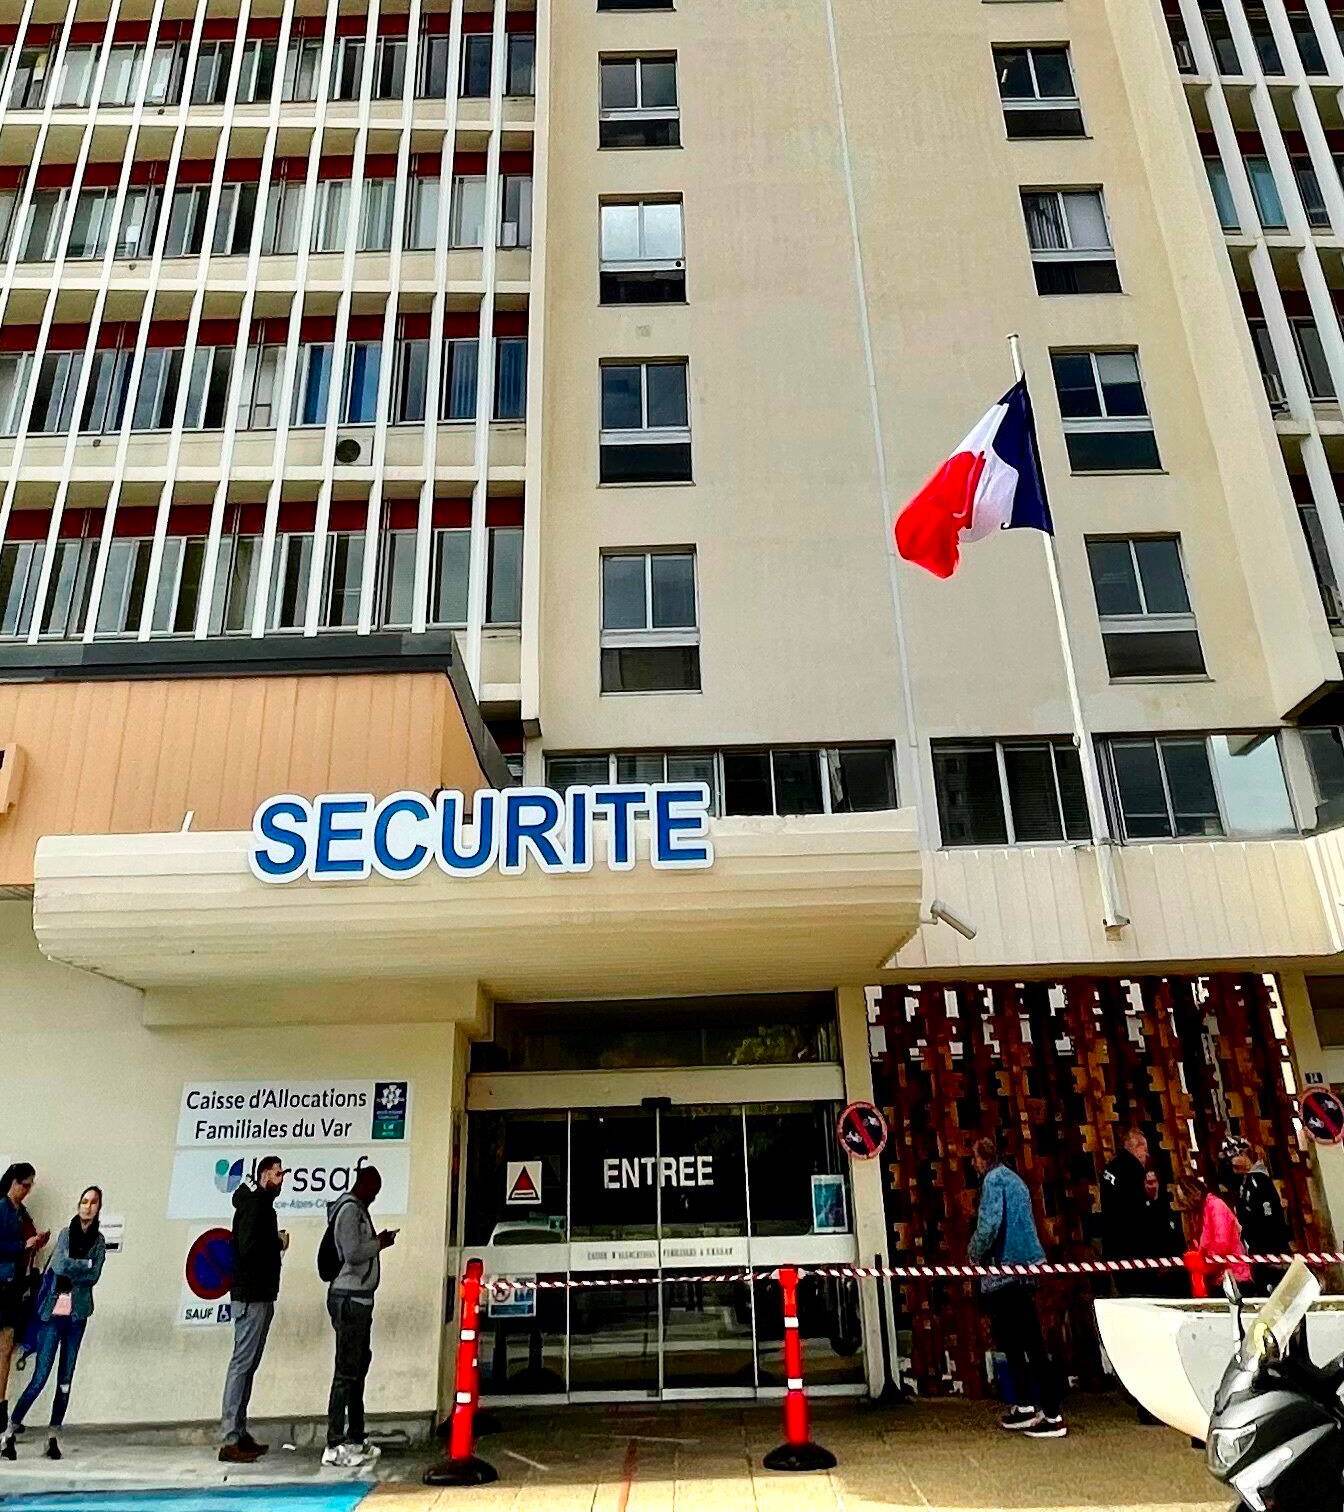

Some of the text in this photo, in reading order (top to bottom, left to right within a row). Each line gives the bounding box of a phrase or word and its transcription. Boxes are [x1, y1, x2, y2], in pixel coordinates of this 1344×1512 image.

[255, 790, 708, 875] SECURITE
[186, 1088, 367, 1110] Caisse d'Allocations
[195, 1117, 353, 1140] Familiales du Var
[603, 1155, 714, 1189] ENTREE
[184, 1307, 214, 1320] SAUF
